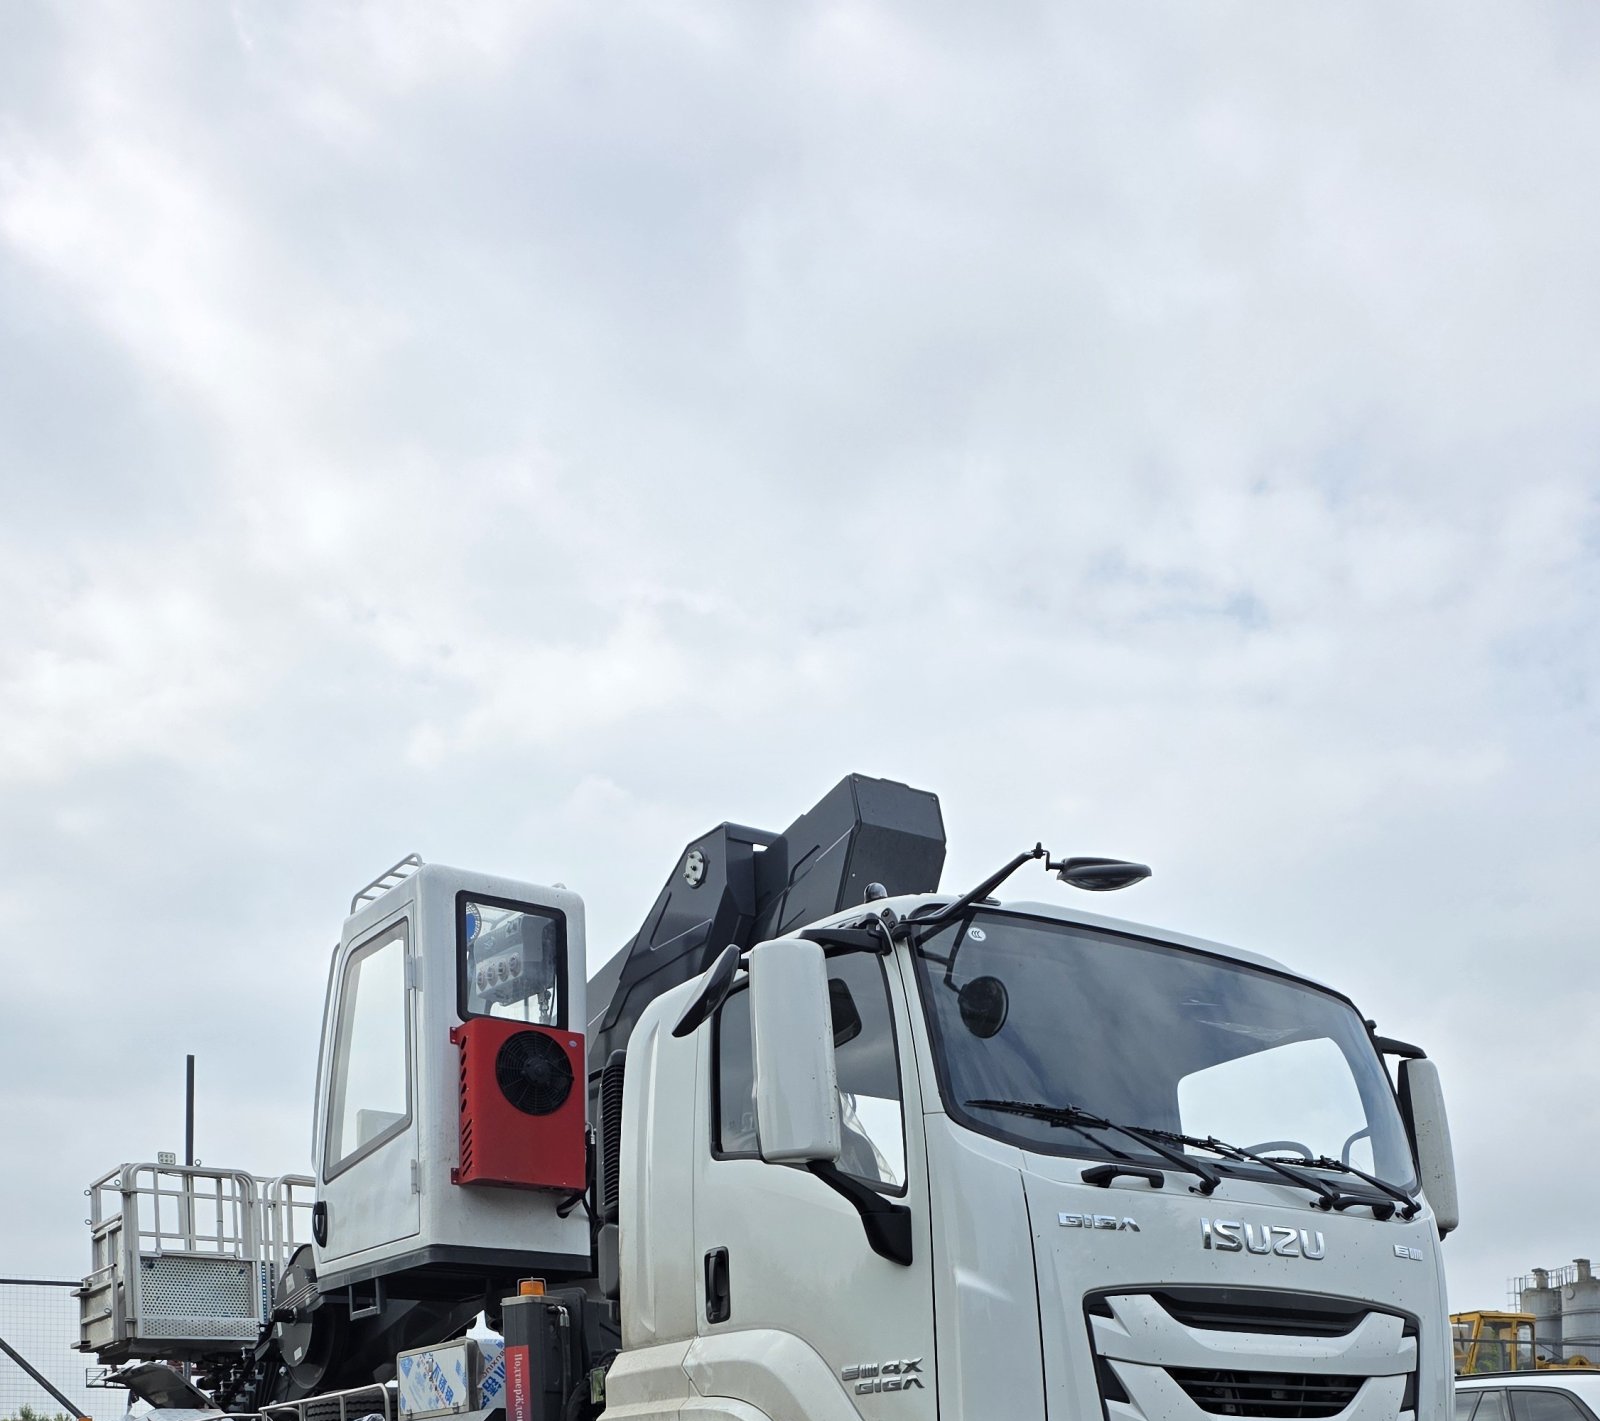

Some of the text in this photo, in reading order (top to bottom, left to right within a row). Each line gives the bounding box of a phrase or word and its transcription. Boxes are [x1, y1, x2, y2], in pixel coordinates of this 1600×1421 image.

[1057, 1212, 1141, 1232] GIGA
[1200, 1217, 1325, 1260] ISUZU
[854, 1375, 925, 1395] GIGA
